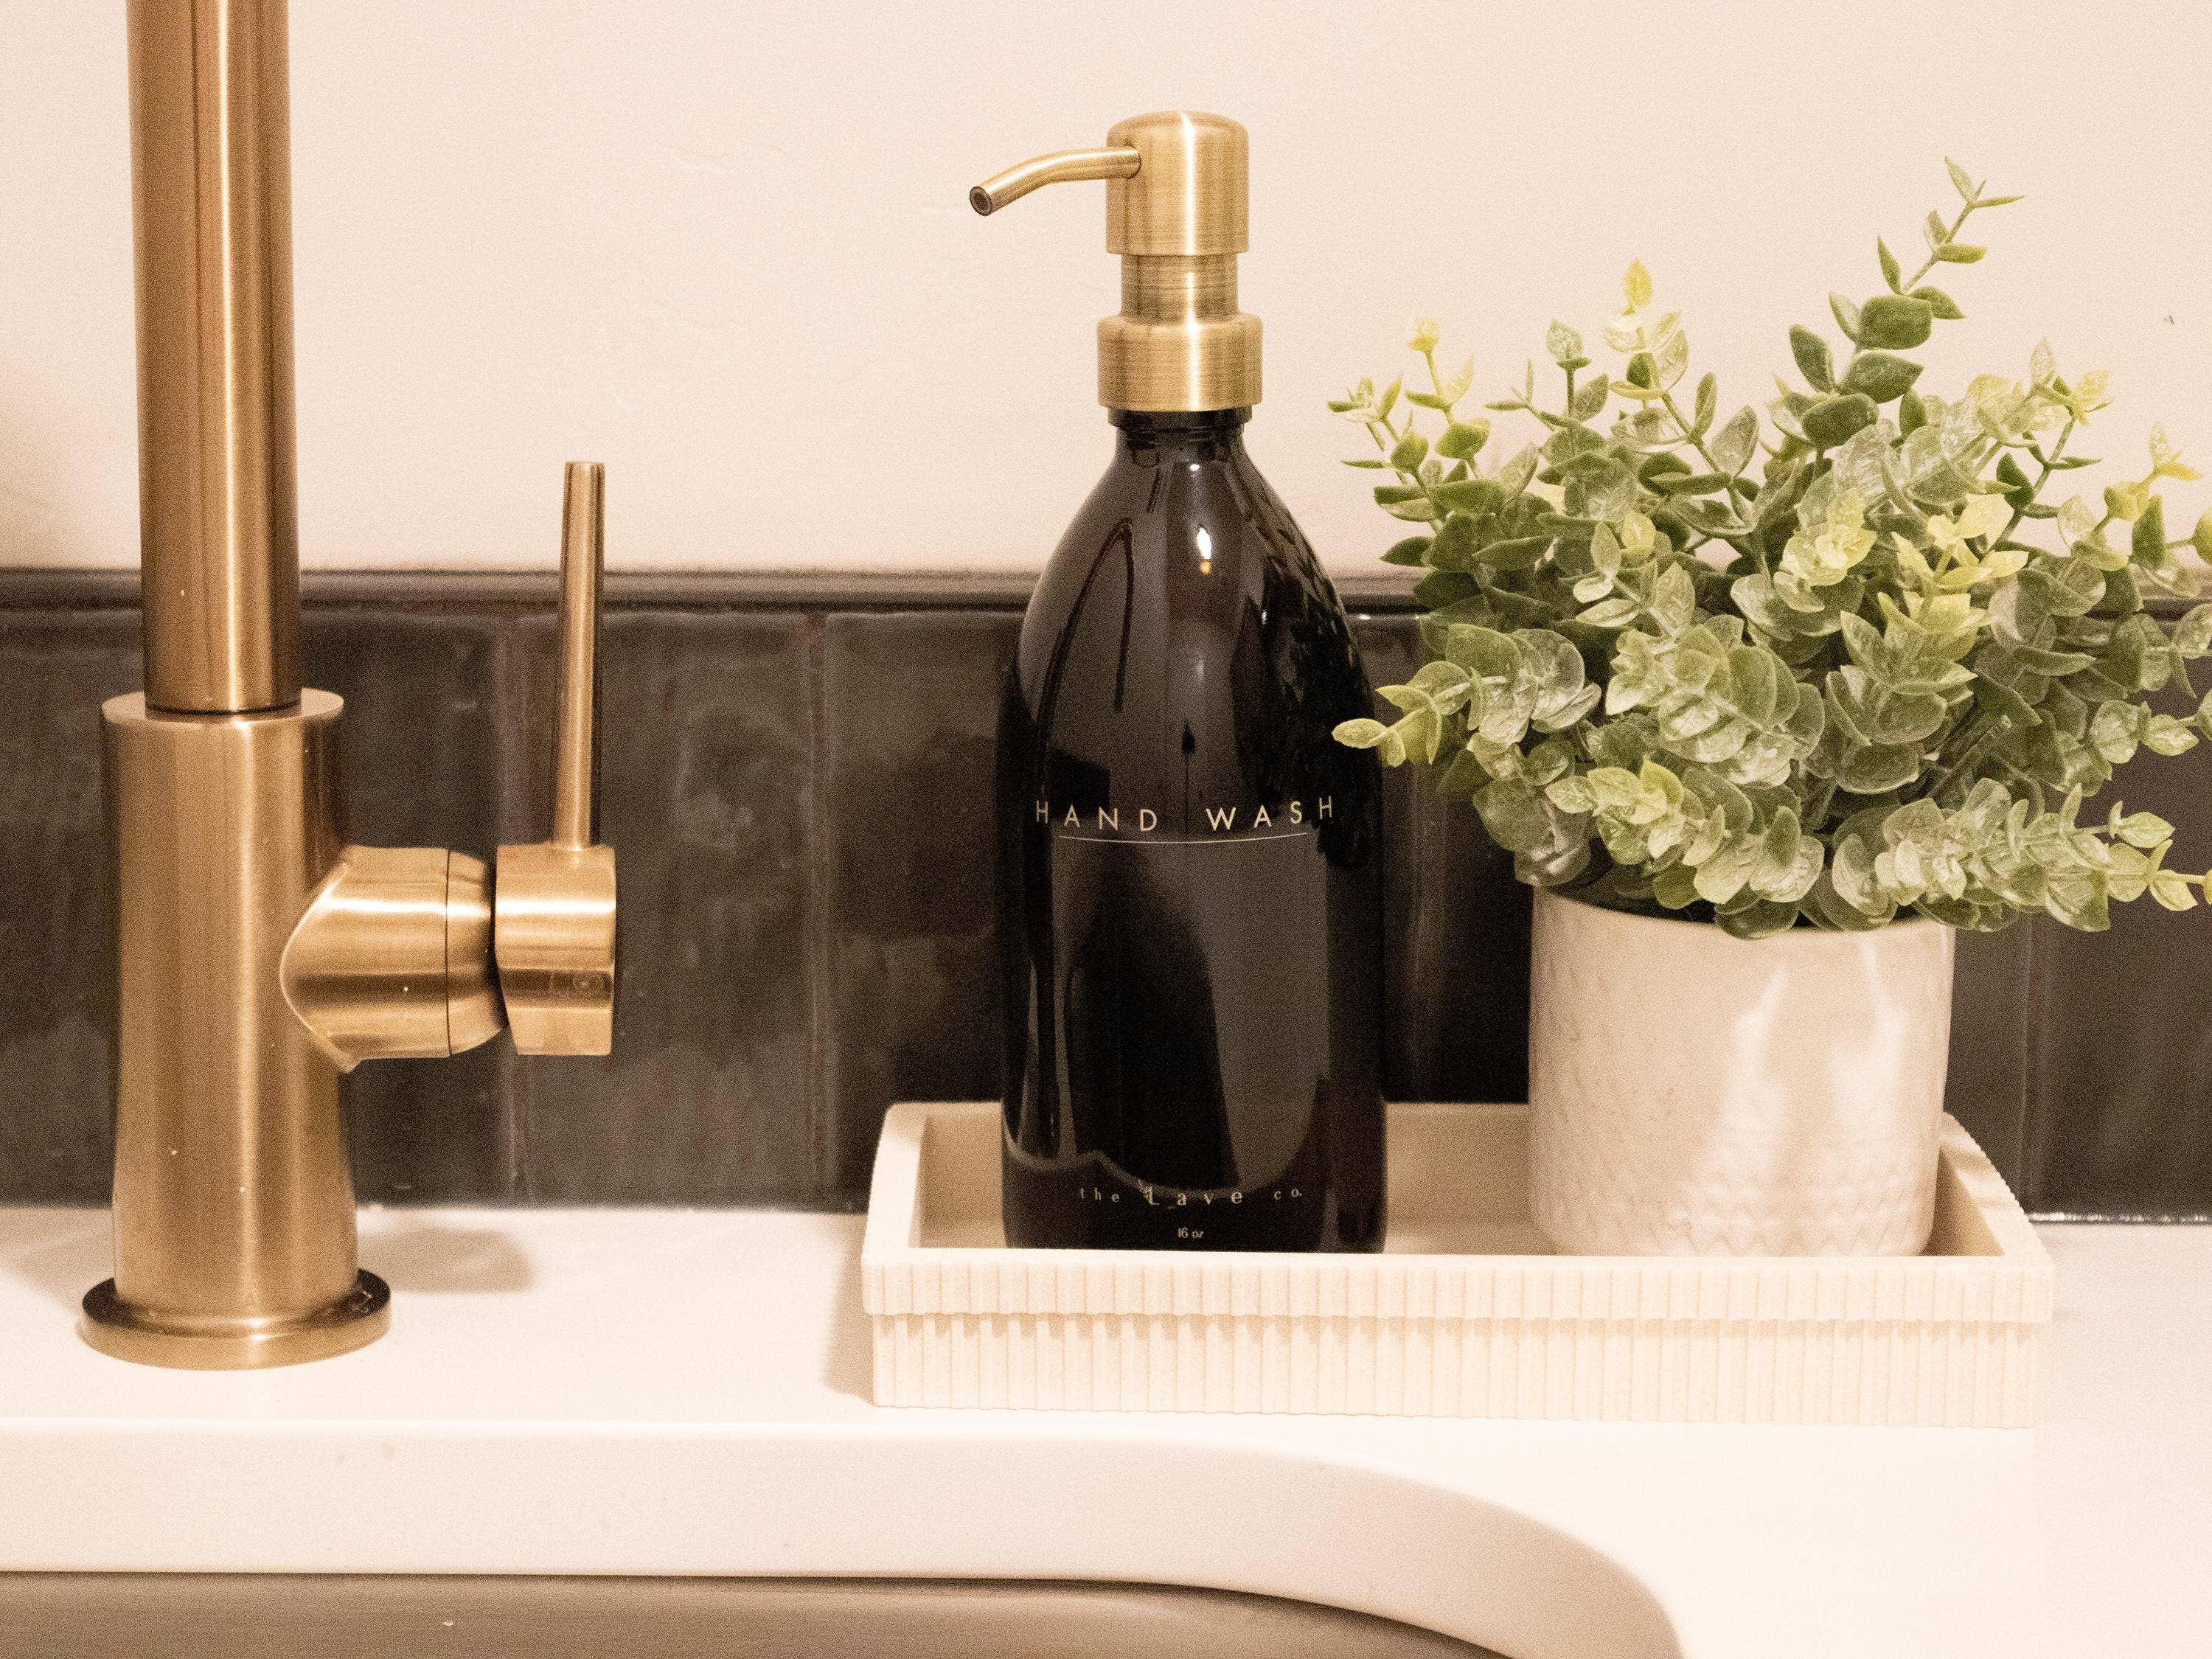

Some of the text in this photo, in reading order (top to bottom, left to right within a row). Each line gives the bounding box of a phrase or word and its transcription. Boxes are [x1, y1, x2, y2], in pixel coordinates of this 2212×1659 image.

[1035, 796, 1332, 831] HAND WASH
[1079, 1187, 1120, 1202] the
[1144, 1186, 1243, 1206] Lave
[1178, 1227, 1204, 1239] 16 oz
